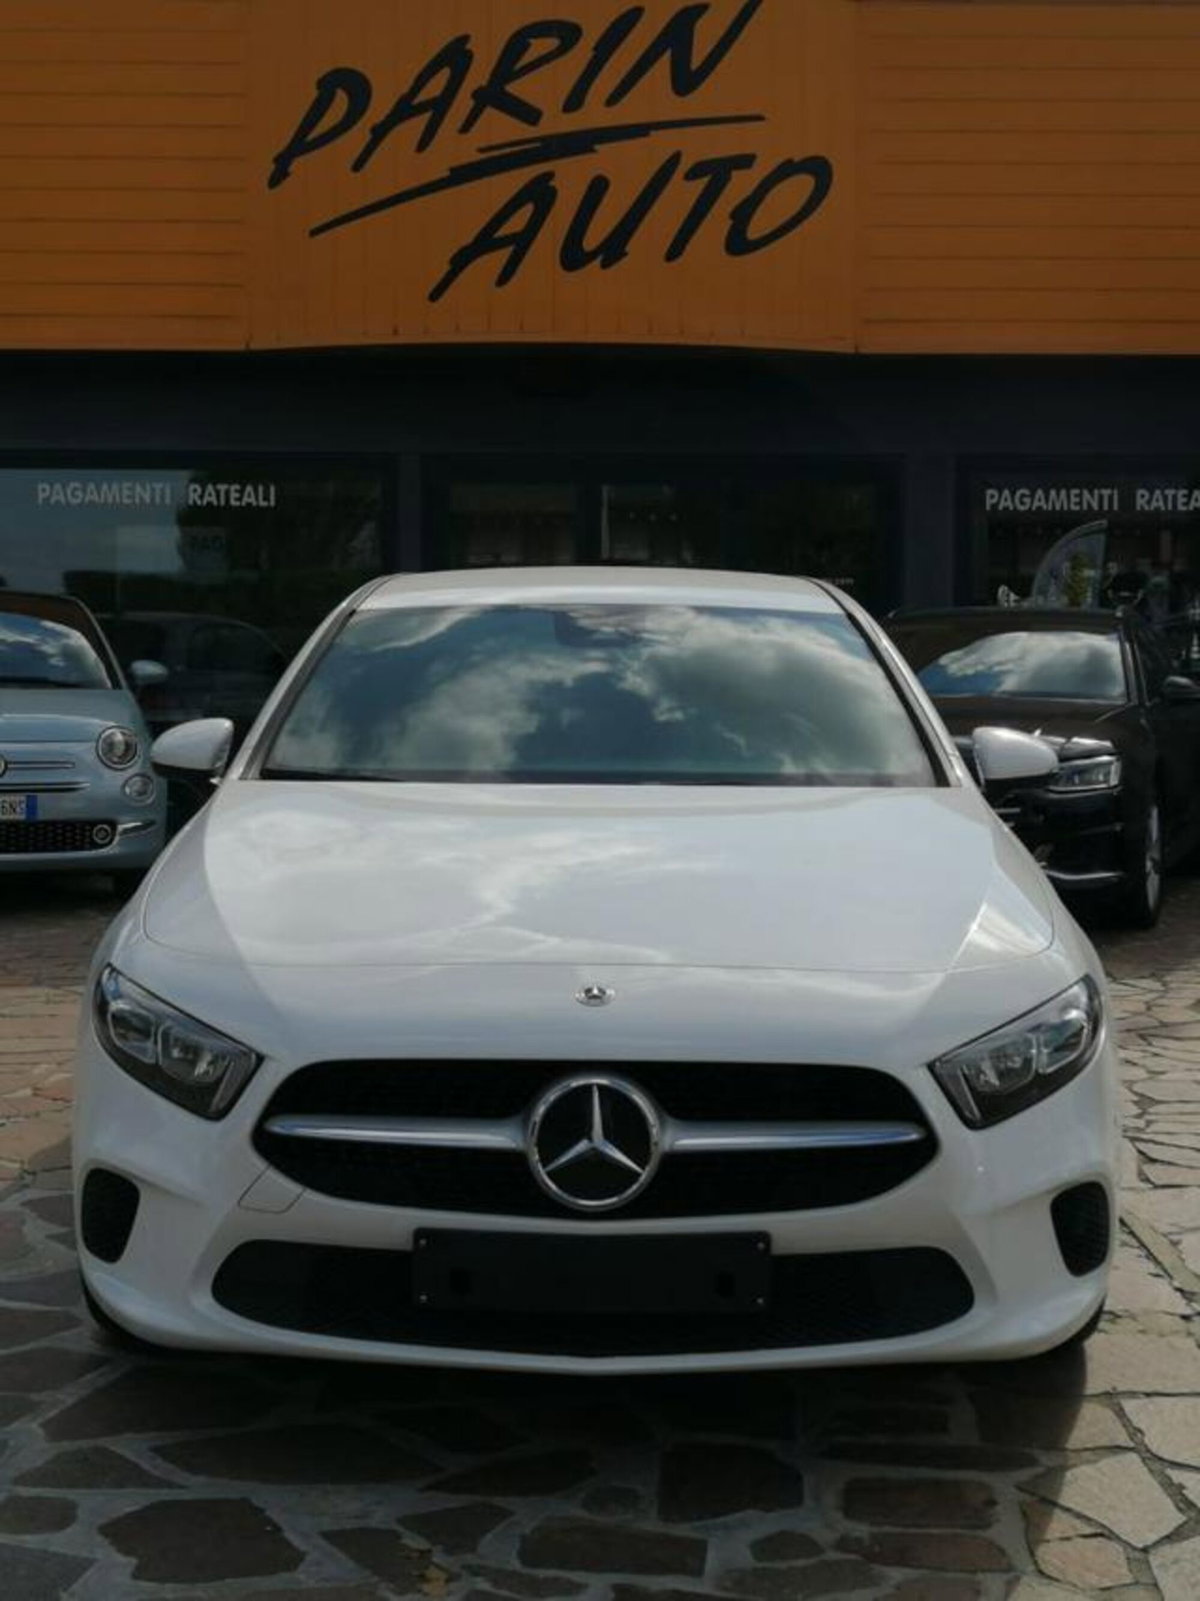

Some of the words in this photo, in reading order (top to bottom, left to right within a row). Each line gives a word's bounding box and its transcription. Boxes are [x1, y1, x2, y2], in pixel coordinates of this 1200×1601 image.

[268, 0, 762, 189] PARIN
[428, 151, 832, 302] AUTO
[37, 483, 171, 504] PAGAMENTI
[188, 484, 276, 507] RATEALI
[985, 488, 1119, 511] PAGAMENTI
